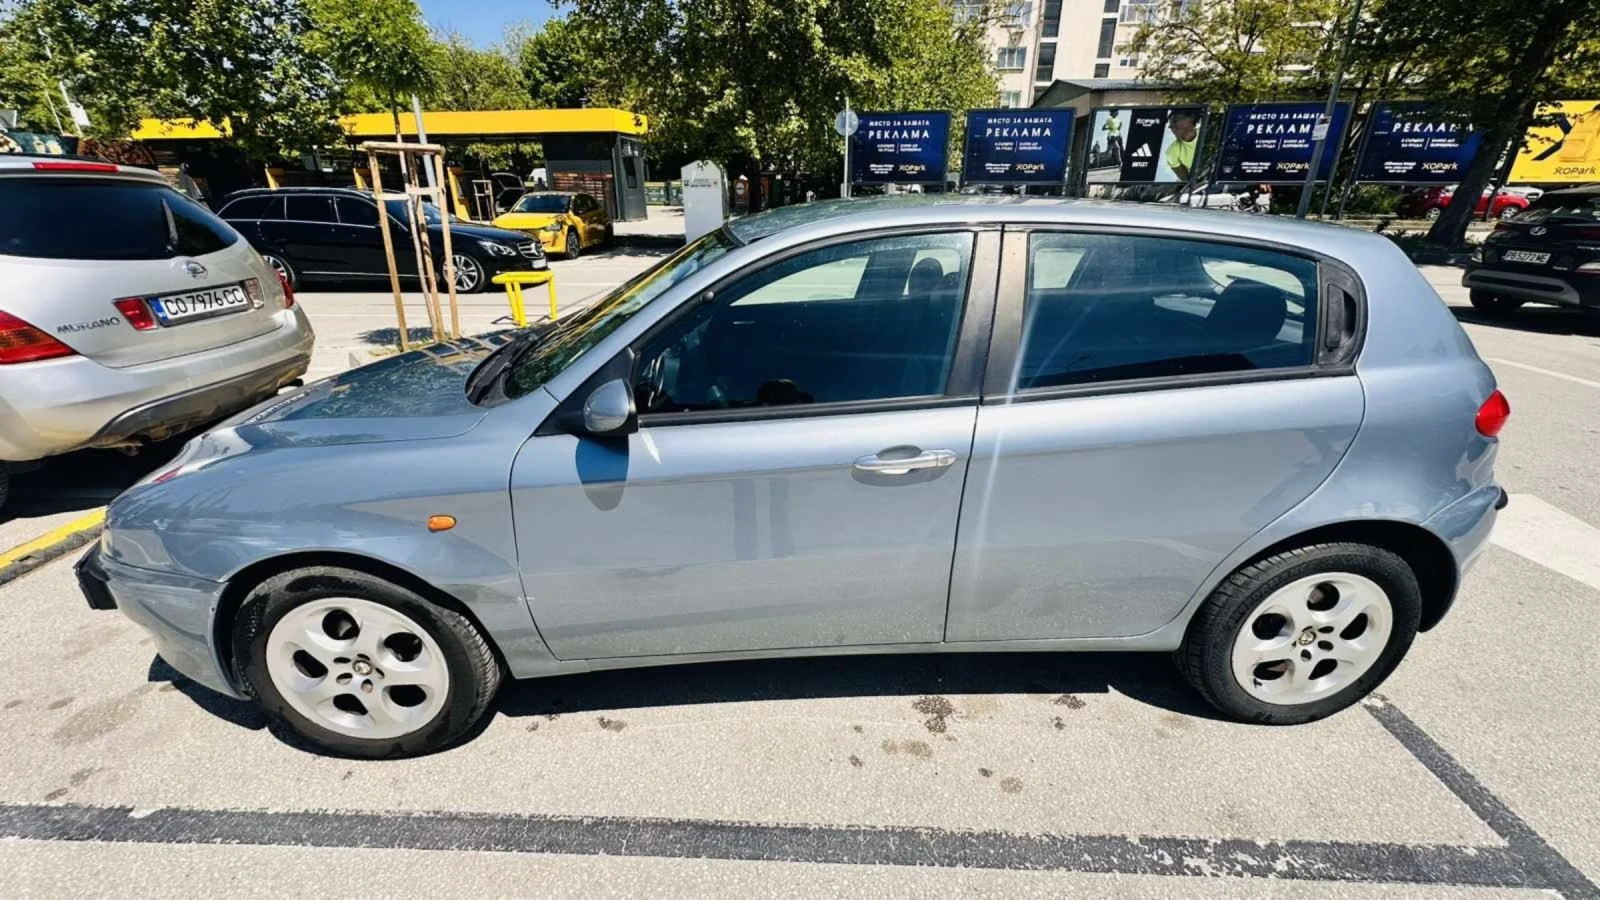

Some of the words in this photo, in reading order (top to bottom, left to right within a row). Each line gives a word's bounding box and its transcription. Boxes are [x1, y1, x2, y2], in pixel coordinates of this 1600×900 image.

[985, 127, 1051, 137] РЕКЛАМА
[1246, 123, 1312, 134] РЕКЛАМ
[868, 129, 929, 139] РЕКЛАМА
[1276, 162, 1311, 170] XOPark
[1421, 162, 1459, 170] XOPark
[1553, 166, 1597, 175] XOPark
[57, 316, 120, 334] MURANO
